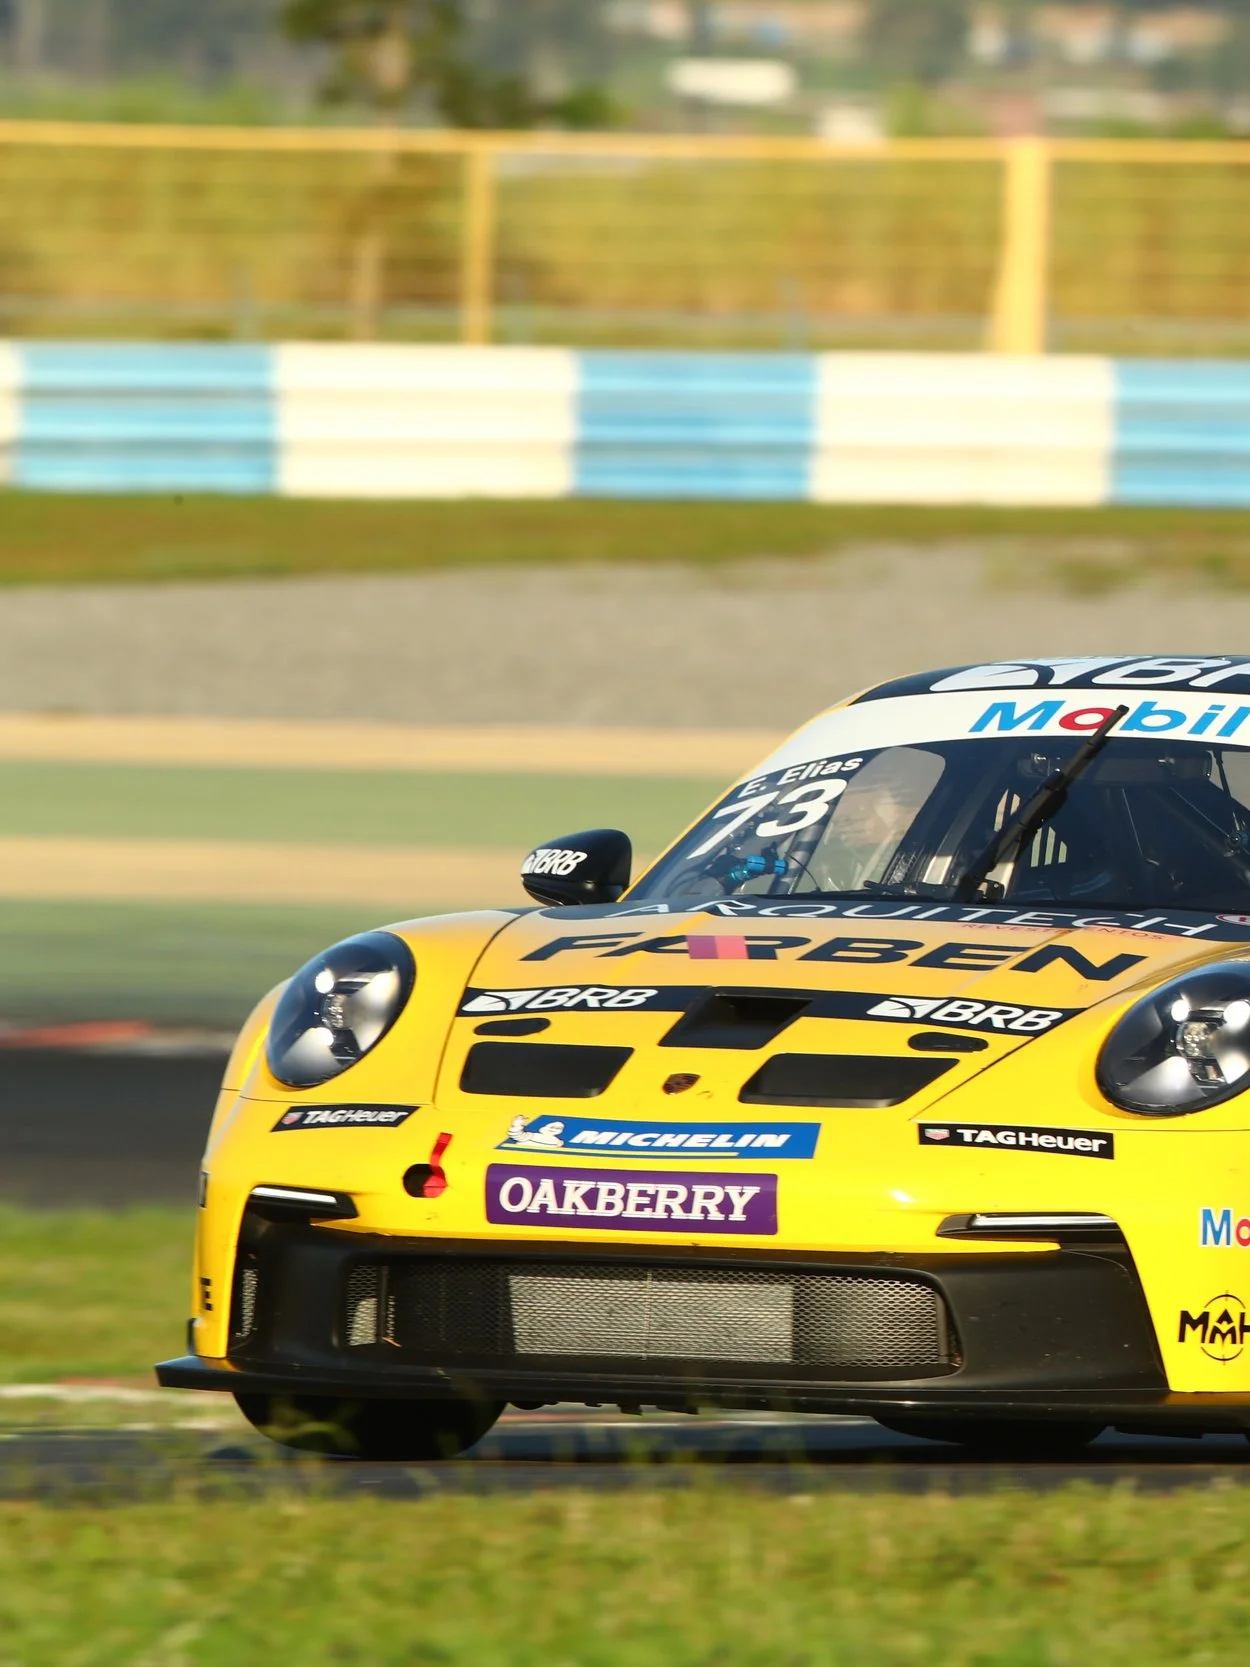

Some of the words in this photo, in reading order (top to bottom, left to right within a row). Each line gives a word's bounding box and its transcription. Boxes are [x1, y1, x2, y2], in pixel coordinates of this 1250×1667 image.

[738, 776, 767, 798] E.
[777, 757, 863, 785] Elias
[686, 778, 848, 859] 73
[534, 849, 588, 875] BRB
[520, 932, 1150, 981] FARBEN
[525, 987, 659, 1009] BRB
[930, 999, 1063, 1031] BRB
[568, 1130, 793, 1148] MICHELIN
[499, 1176, 761, 1221] OAKBERRY
